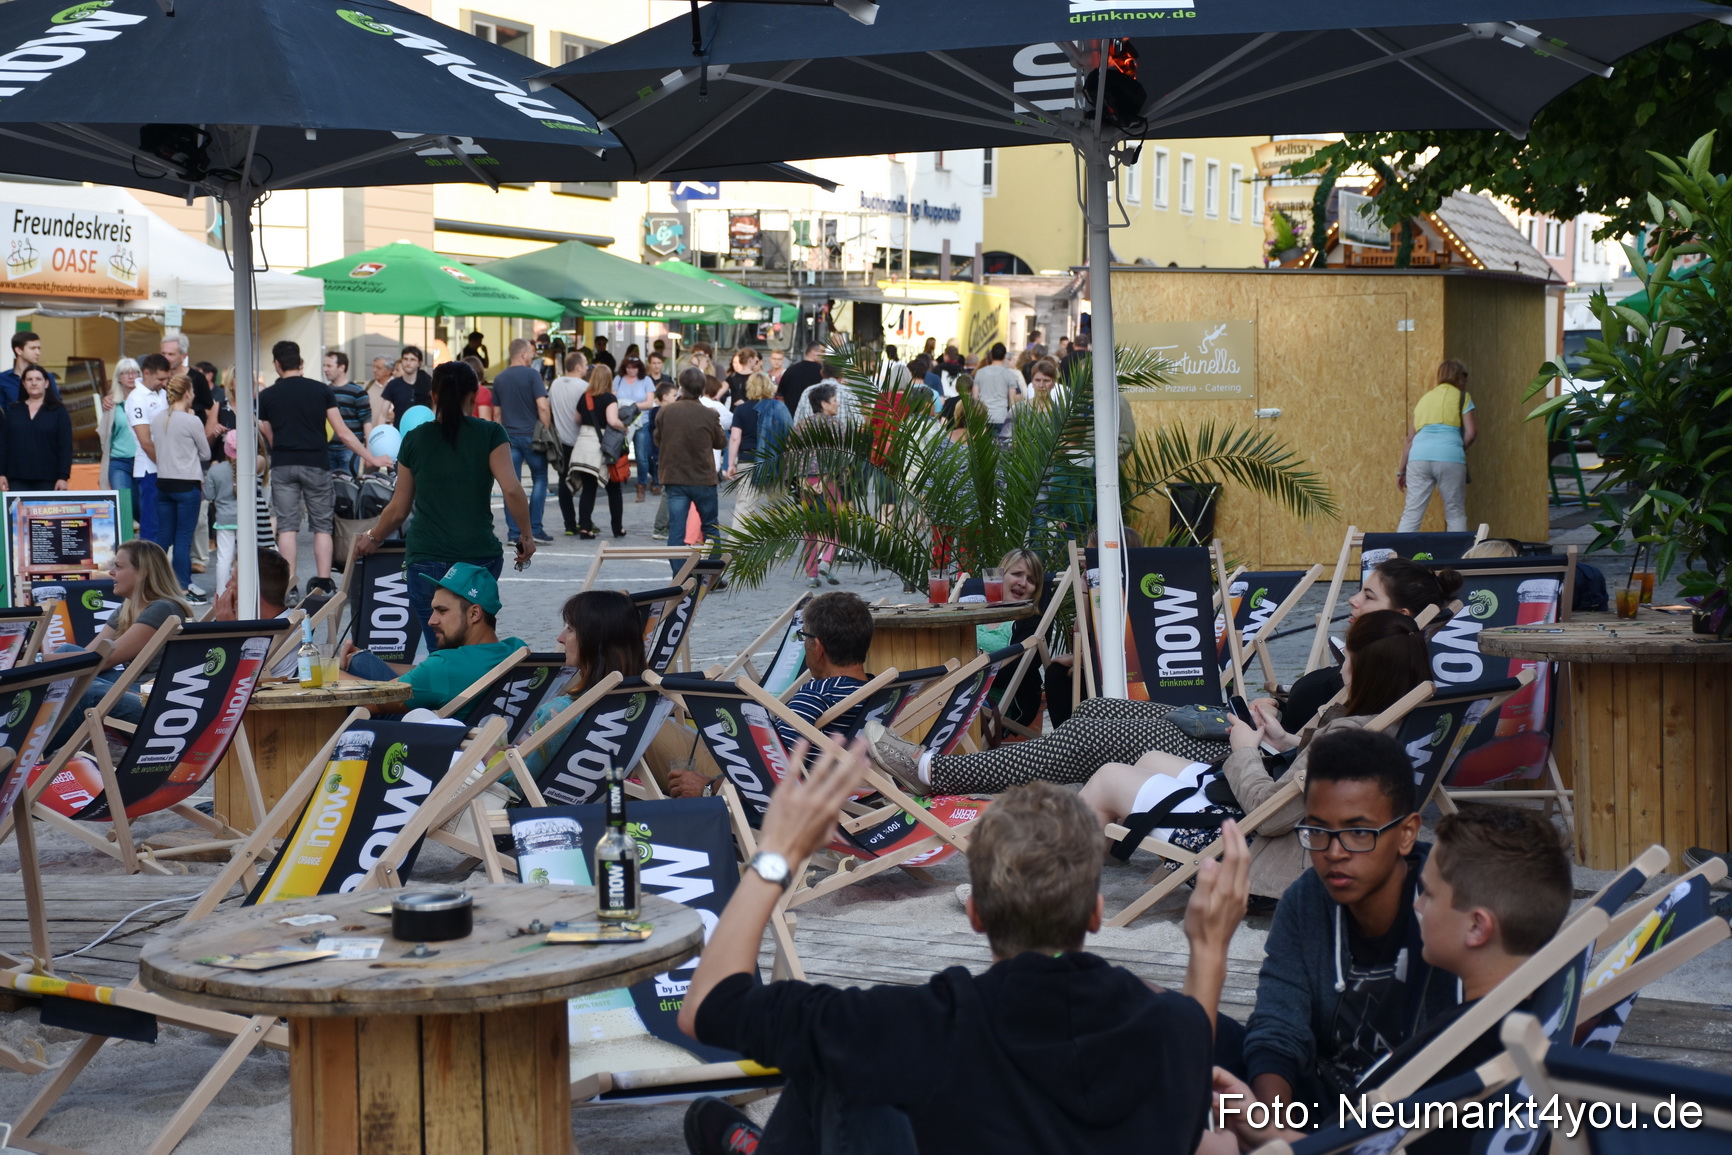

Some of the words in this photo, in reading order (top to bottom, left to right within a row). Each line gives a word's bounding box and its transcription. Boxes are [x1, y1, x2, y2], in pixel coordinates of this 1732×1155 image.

[1069, 10, 1197, 24] drinknow.de
[1275, 142, 1314, 158] Melissa's
[860, 189, 920, 225] Buchhandlng
[13, 208, 132, 244] Freundeskreis
[52, 246, 98, 275] OASE
[613, 307, 664, 318] Tradition
[1165, 384, 1197, 393] Pizzeria
[1205, 383, 1242, 394] Catering
[134, 407, 143, 419] 3
[1153, 586, 1203, 673] now
[1159, 677, 1205, 688] drinknow.de
[610, 786, 621, 813] now
[306, 784, 352, 848] now
[949, 808, 978, 820] BERRY
[883, 820, 901, 835] 100%
[297, 856, 323, 866] ORANGE
[608, 864, 625, 898] now
[662, 985, 673, 994] by
